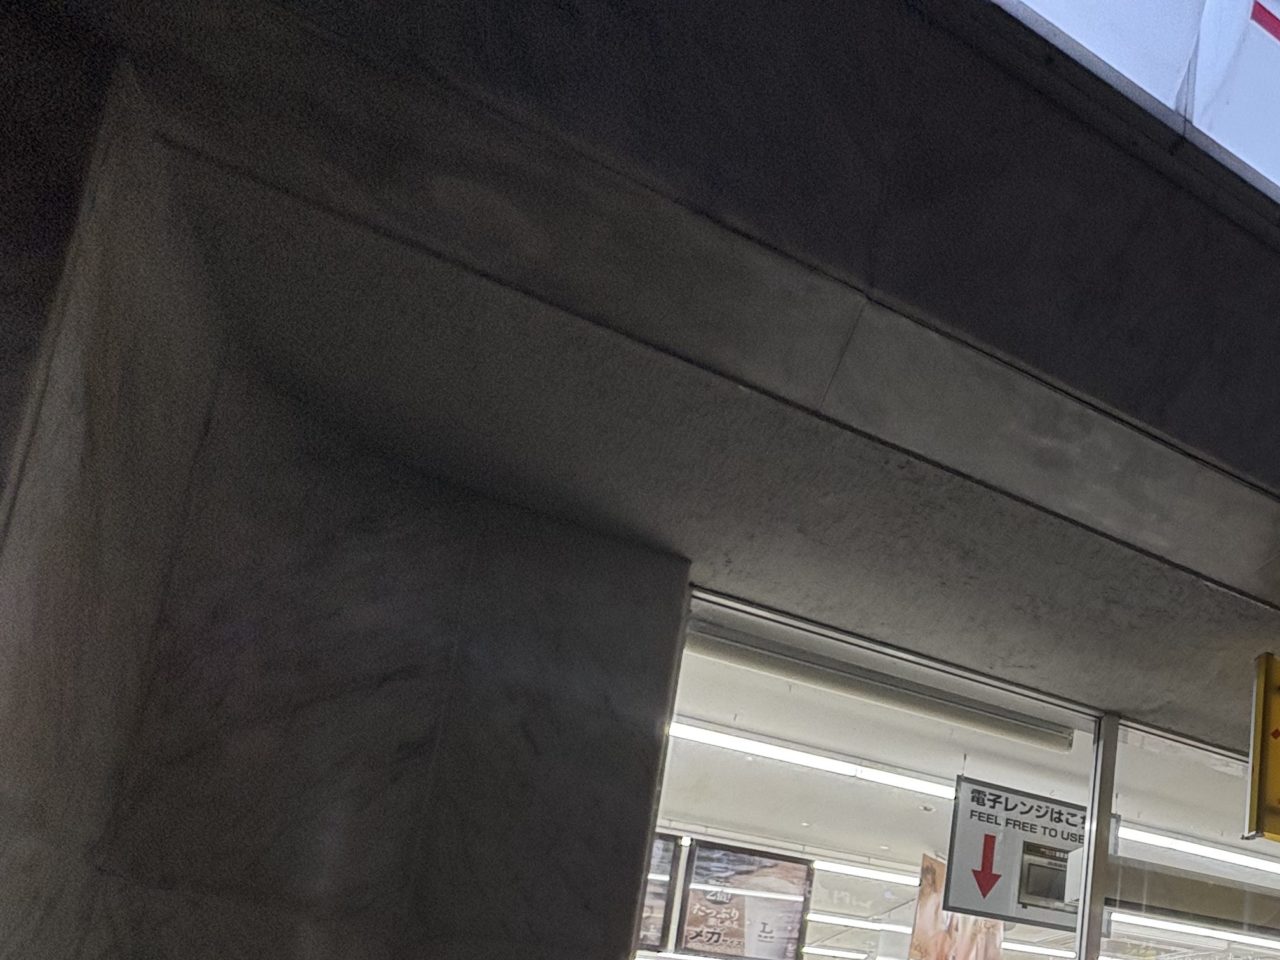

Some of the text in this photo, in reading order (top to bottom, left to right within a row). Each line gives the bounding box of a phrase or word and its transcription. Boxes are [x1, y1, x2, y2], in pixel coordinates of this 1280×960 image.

[970, 809, 1085, 844] FEEL FREE TO USE
